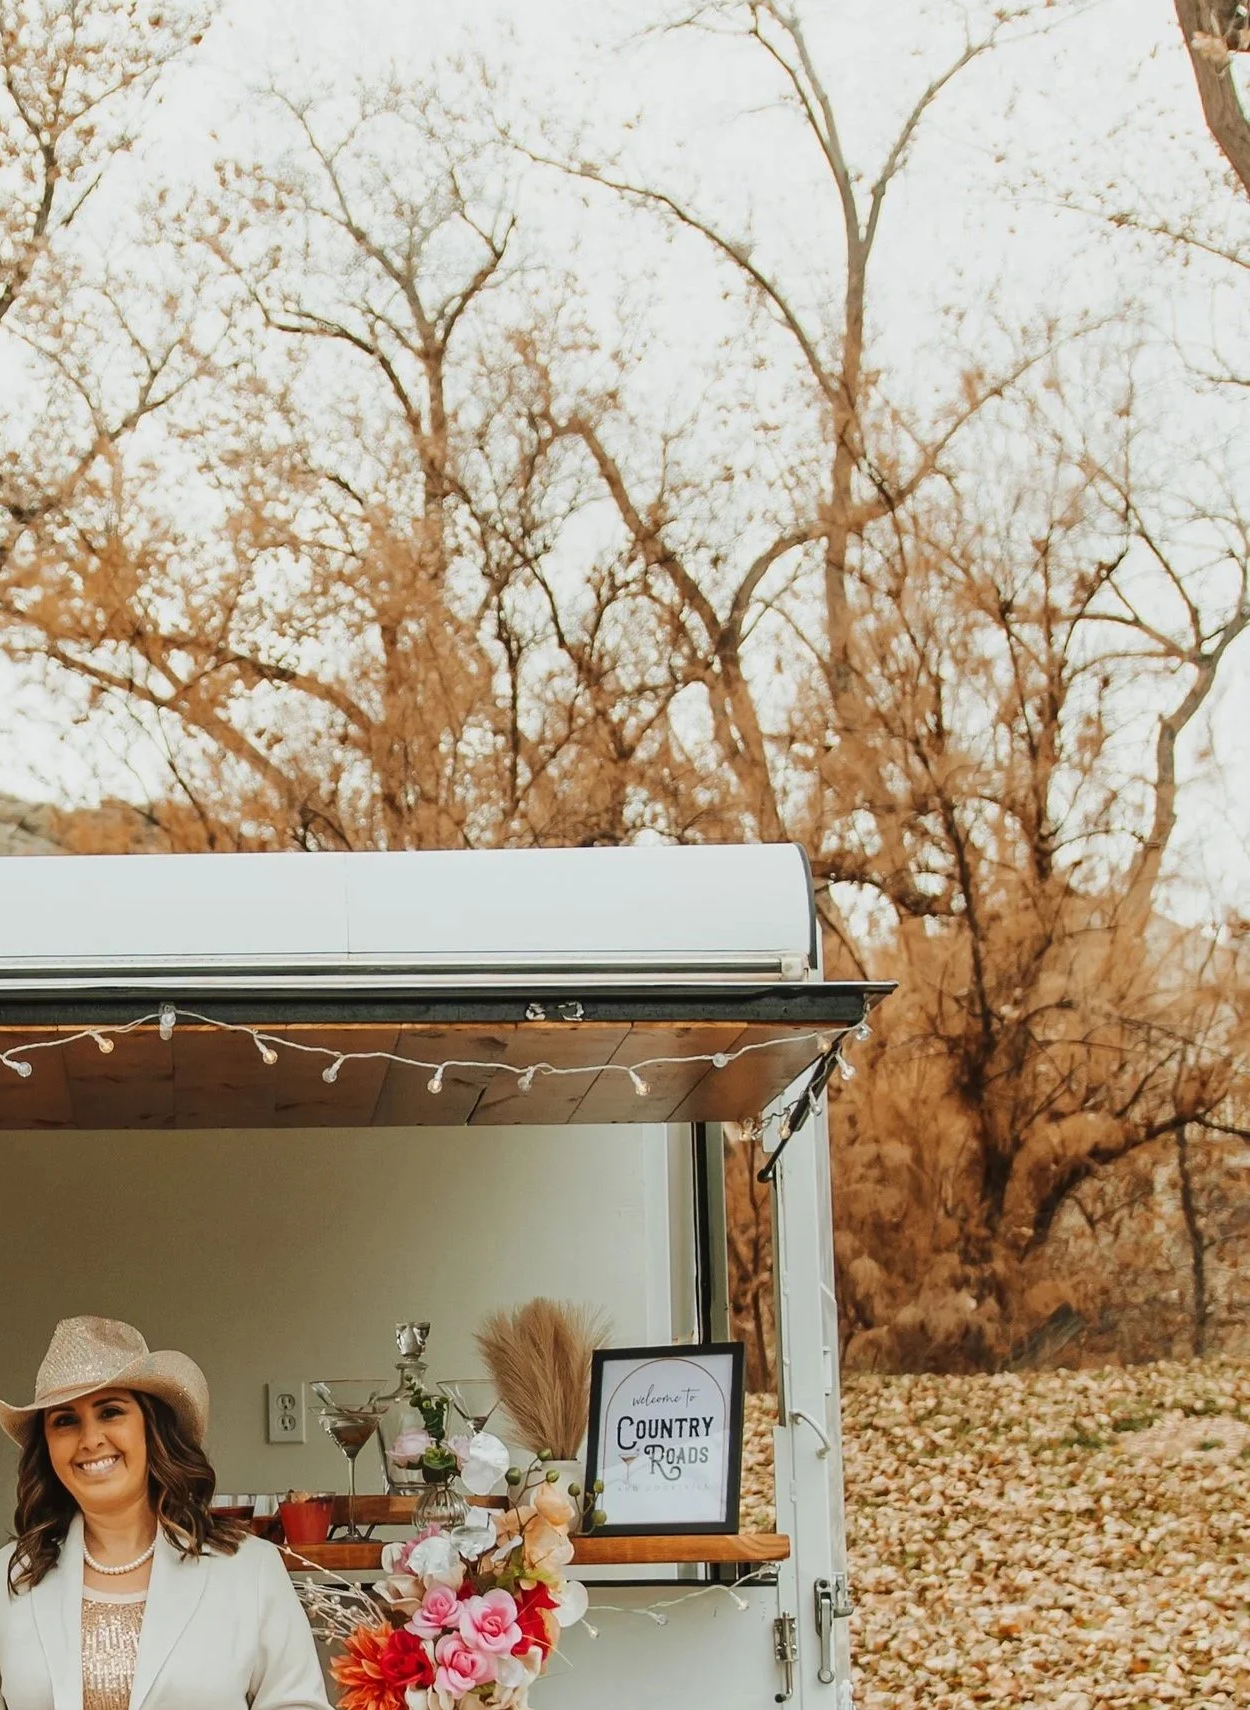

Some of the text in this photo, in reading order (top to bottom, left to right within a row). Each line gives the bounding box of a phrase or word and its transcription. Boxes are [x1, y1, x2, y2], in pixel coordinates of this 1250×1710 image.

[632, 1384, 701, 1408] welcome to
[617, 1416, 714, 1450] COUNTRY
[644, 1444, 709, 1481] ROADS
